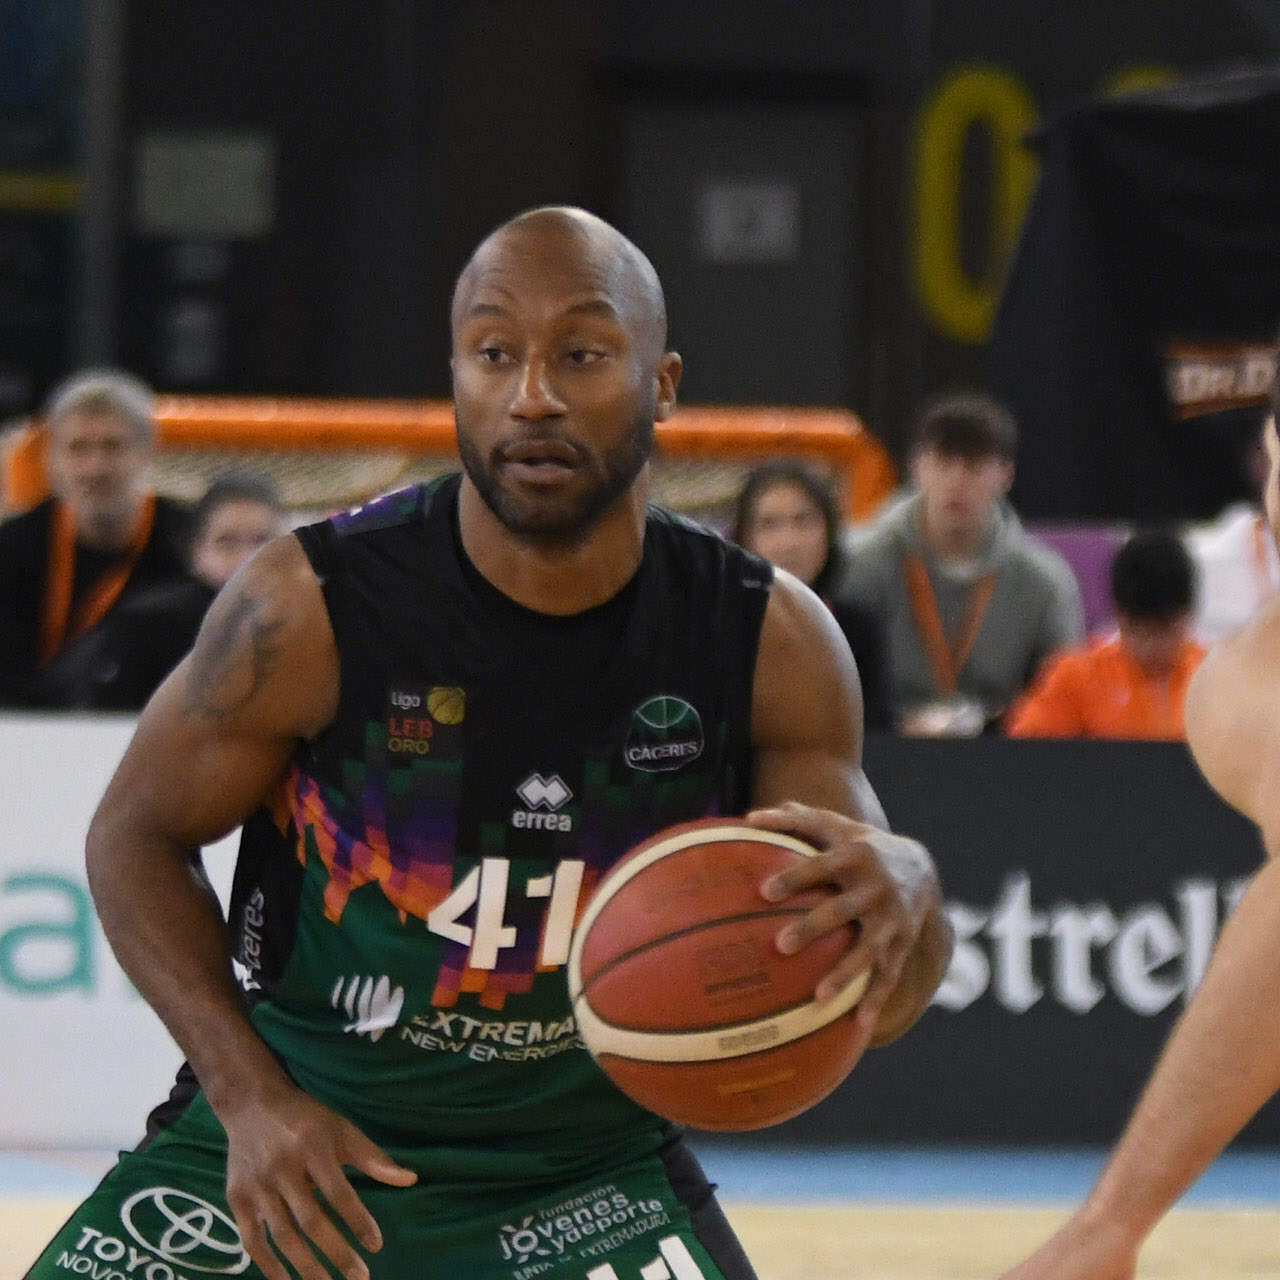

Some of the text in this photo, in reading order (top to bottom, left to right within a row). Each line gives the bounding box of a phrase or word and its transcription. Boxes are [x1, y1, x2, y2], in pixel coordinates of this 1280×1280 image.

[389, 716, 434, 739] LEB
[388, 737, 430, 756] ORO
[427, 856, 586, 971] 41
[929, 870, 1256, 1015] strel
[400, 1025, 466, 1053] NEW
